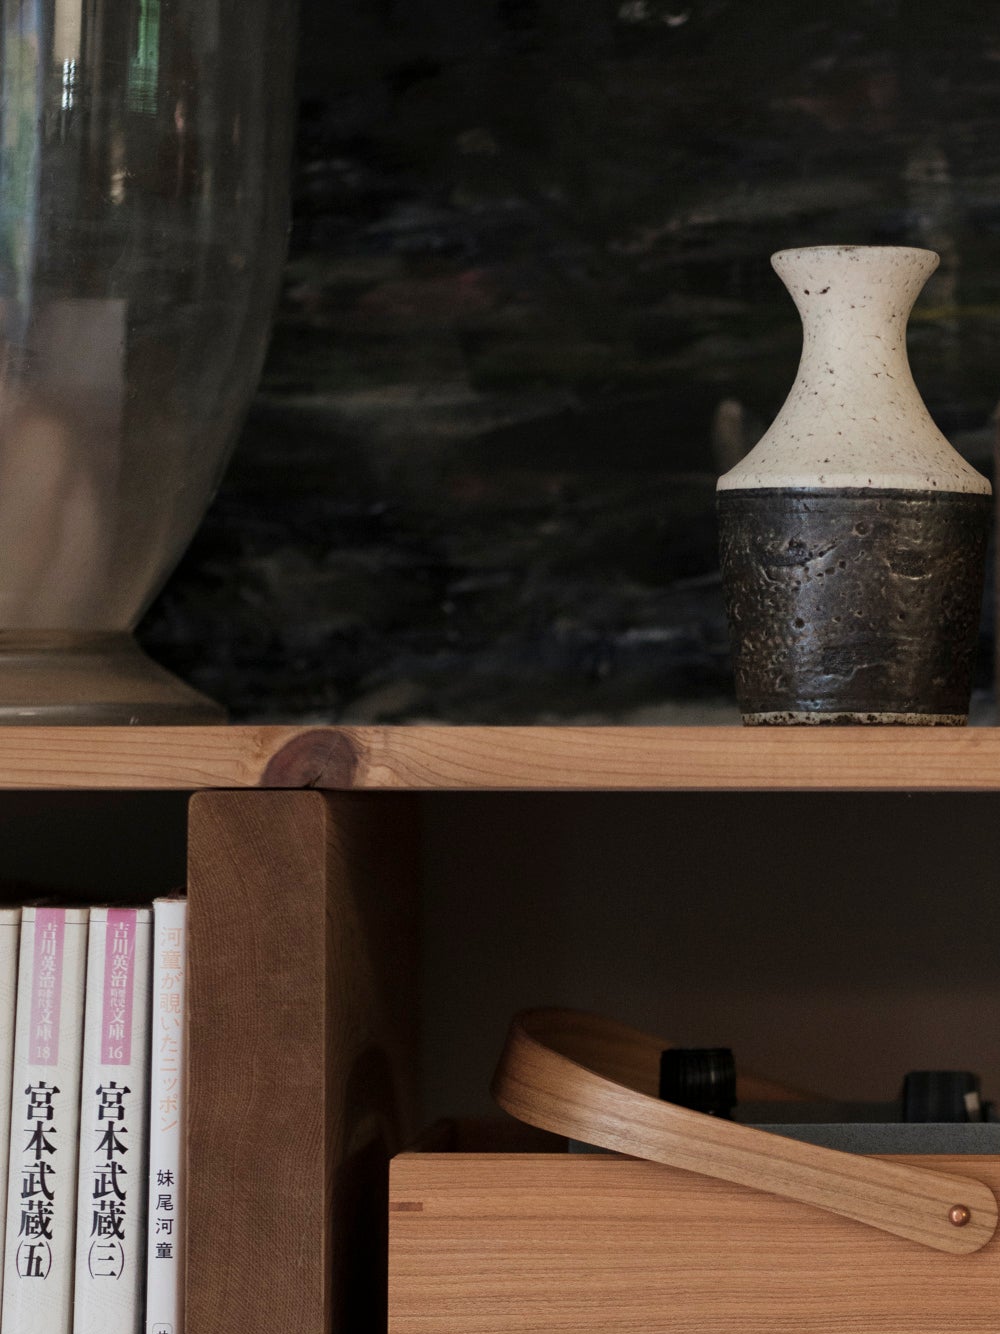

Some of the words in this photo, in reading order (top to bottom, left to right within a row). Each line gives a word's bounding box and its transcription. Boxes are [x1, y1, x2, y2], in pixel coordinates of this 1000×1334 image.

[109, 1047, 123, 1059] 16
[158, 926, 184, 1133] 河童が覗いたニッポン
[155, 1168, 175, 1260] 妹尾河童
